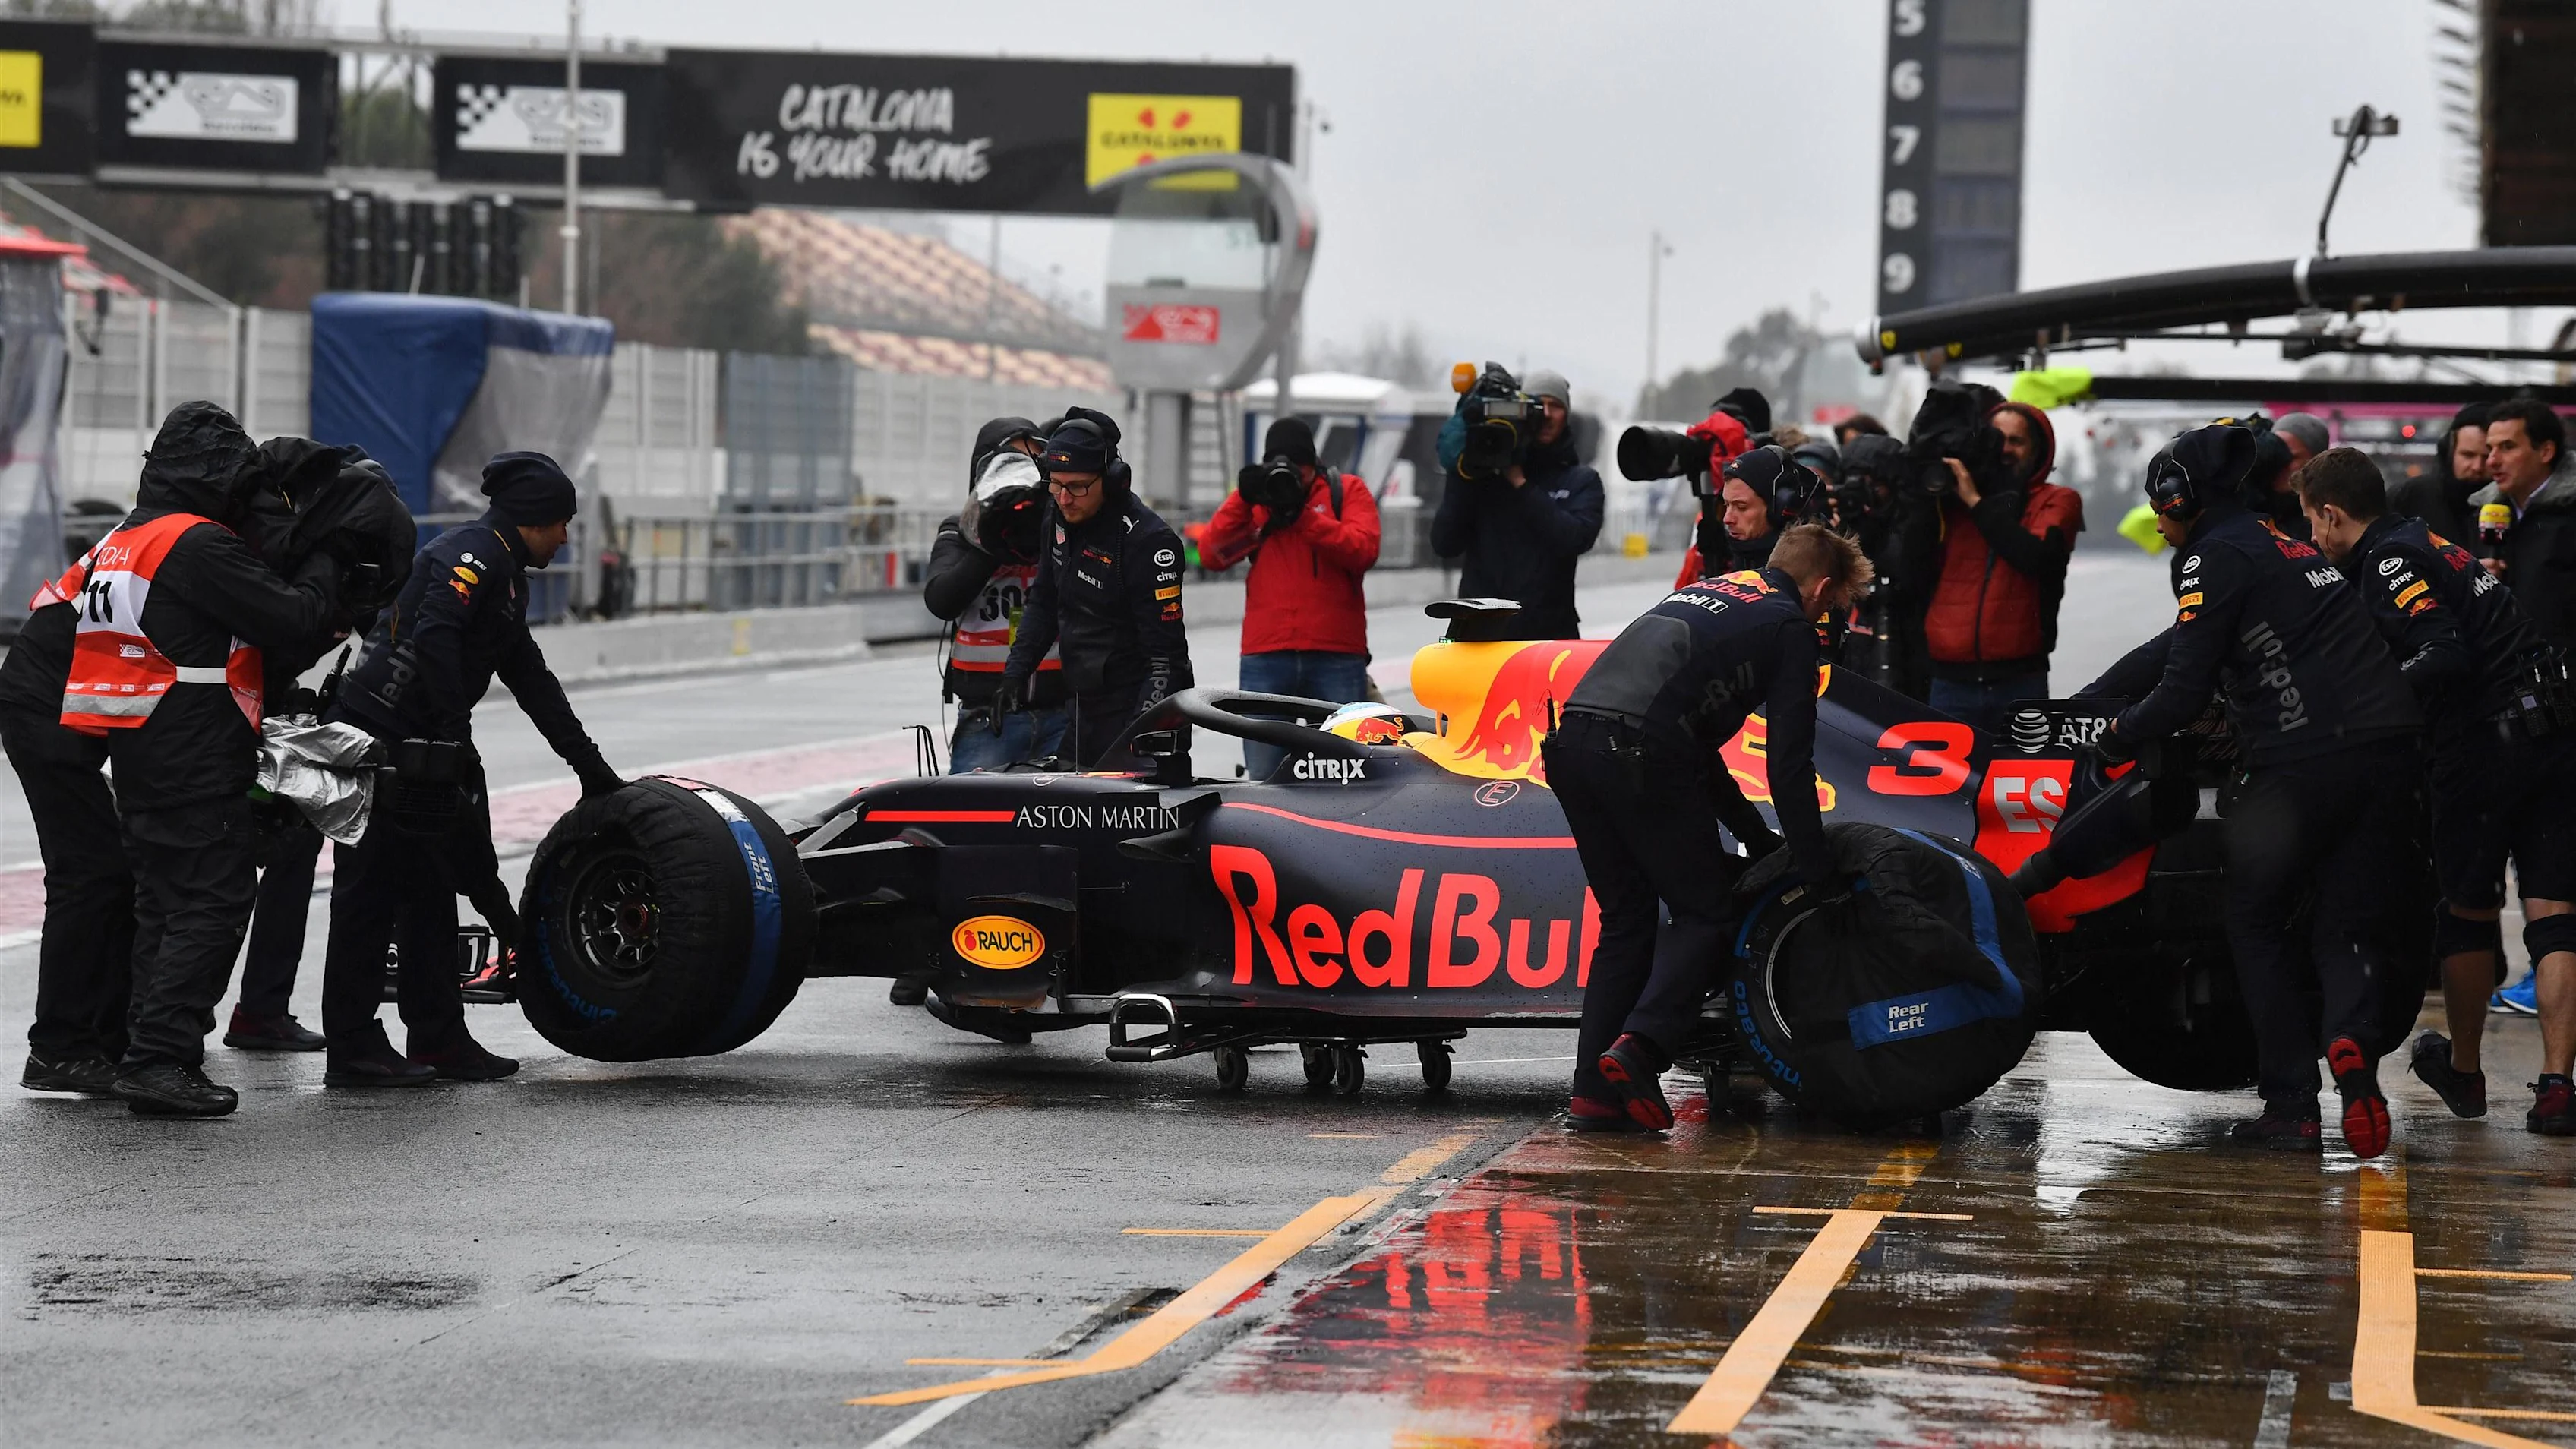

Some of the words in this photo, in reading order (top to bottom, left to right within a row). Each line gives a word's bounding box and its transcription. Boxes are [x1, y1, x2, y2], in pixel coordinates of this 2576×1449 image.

[1894, 0, 1926, 37] 5
[1891, 59, 1924, 101] 6
[737, 130, 781, 178] IS
[787, 130, 877, 182] YOUR
[885, 137, 992, 184] HOME
[1888, 125, 1921, 166] 7
[1885, 189, 1918, 229] 8
[1883, 253, 1915, 294] 9
[96, 546, 131, 566] EDIA
[1078, 570, 1096, 586] Mobil
[2304, 566, 2345, 589] Mobil
[2473, 571, 2500, 597] Mob
[87, 580, 113, 623] 11
[979, 584, 1031, 622] 30
[2058, 717, 2113, 744] AT&
[1867, 721, 1975, 797] 3
[1017, 805, 1091, 829] ASTON
[1101, 805, 1179, 829] MARTIN
[1993, 776, 2065, 833] ES
[743, 841, 766, 892] Front
[758, 855, 774, 894] Left
[1211, 844, 1602, 988] RedBul
[977, 931, 1034, 952] RAUCH
[1888, 1002, 1929, 1019] Rear
[1889, 1016, 1926, 1033] Left
